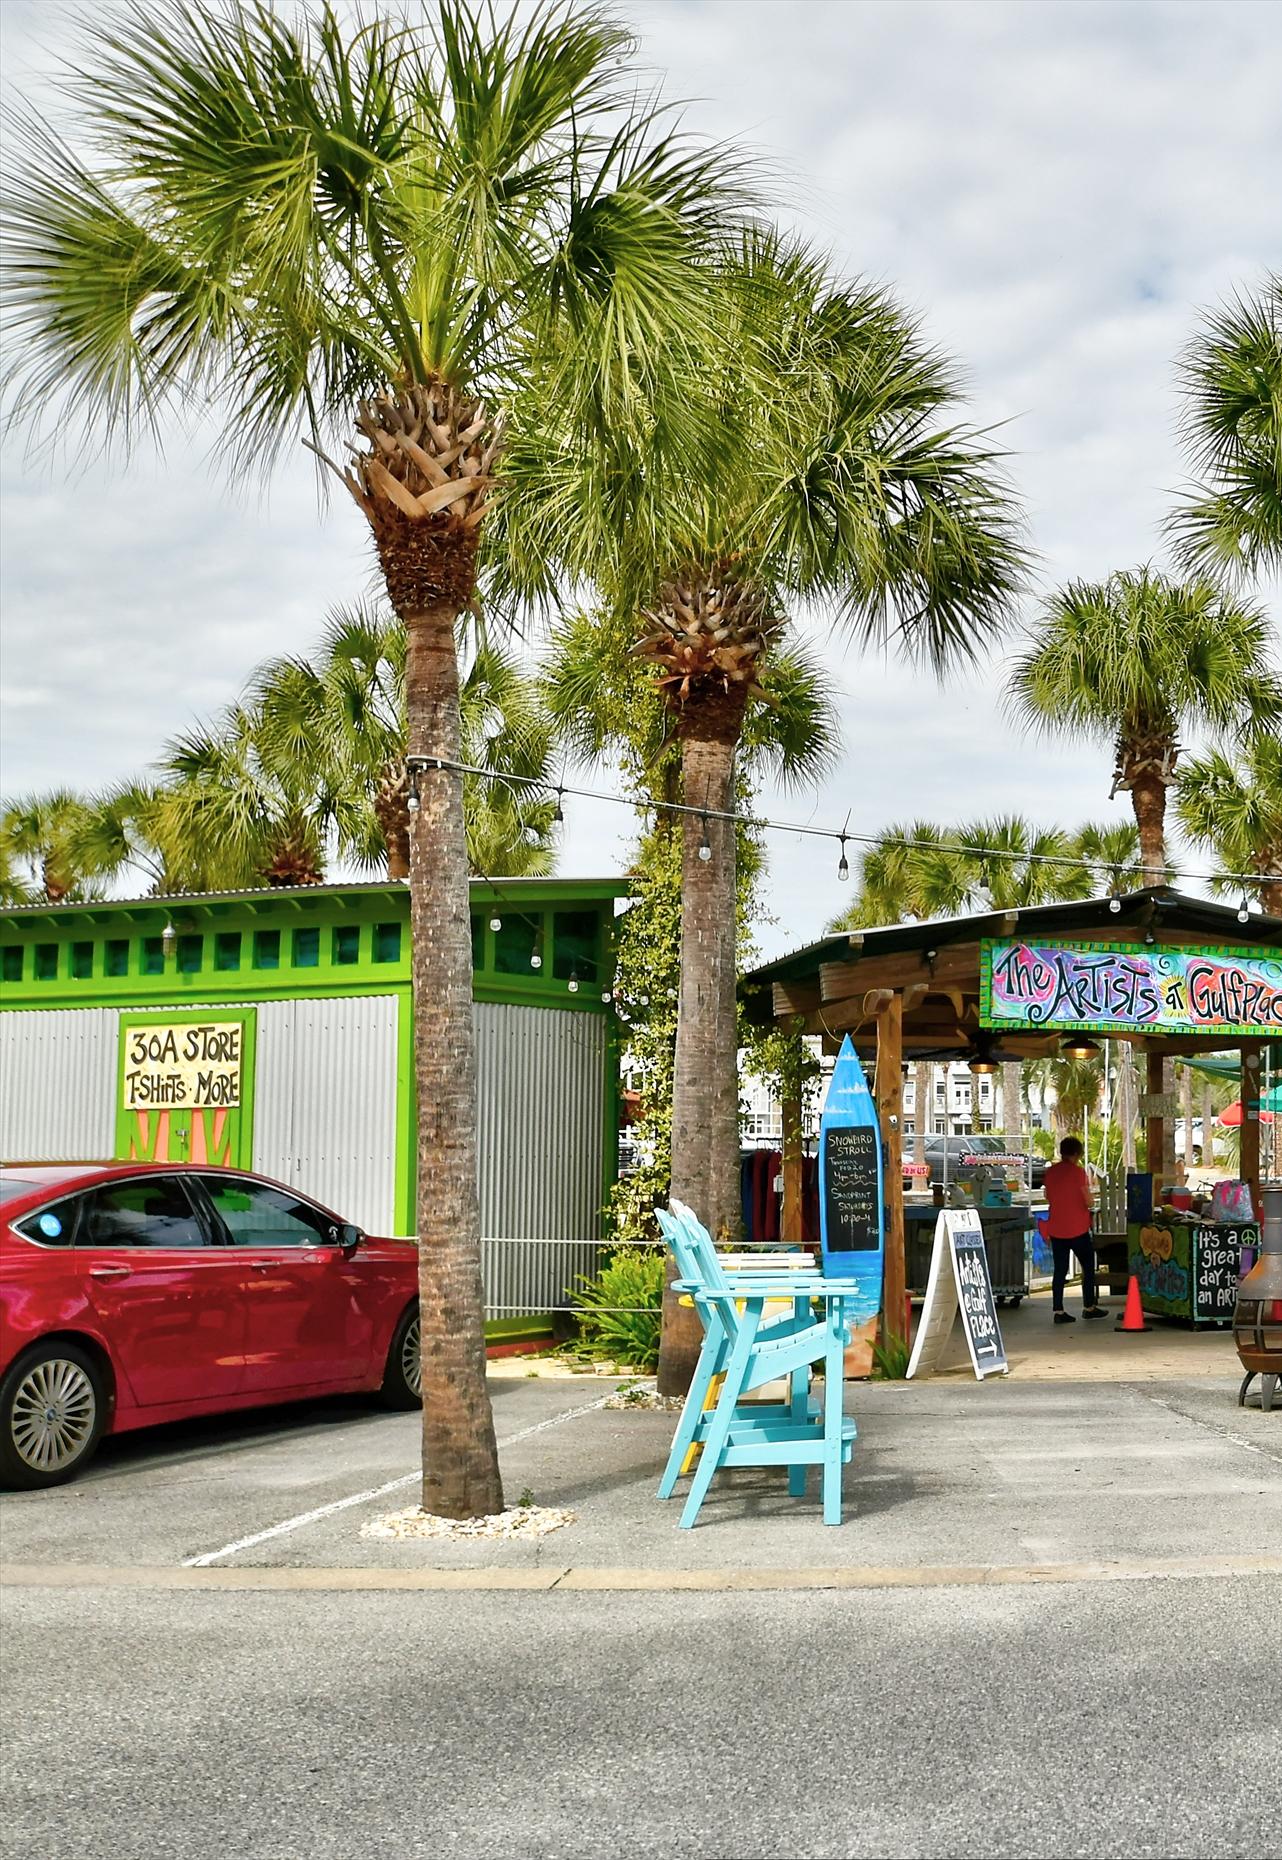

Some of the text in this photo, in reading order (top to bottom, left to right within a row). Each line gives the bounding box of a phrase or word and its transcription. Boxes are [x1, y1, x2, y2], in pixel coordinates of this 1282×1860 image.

[994, 944, 1053, 997] The
[183, 1027, 240, 1062] STORE
[828, 1134, 873, 1147] SNOWBIRD
[837, 1147, 872, 1156] STROLL
[1199, 1230, 1238, 1249] It's a
[1201, 1246, 1242, 1268] great
[1198, 1290, 1212, 1305] an
